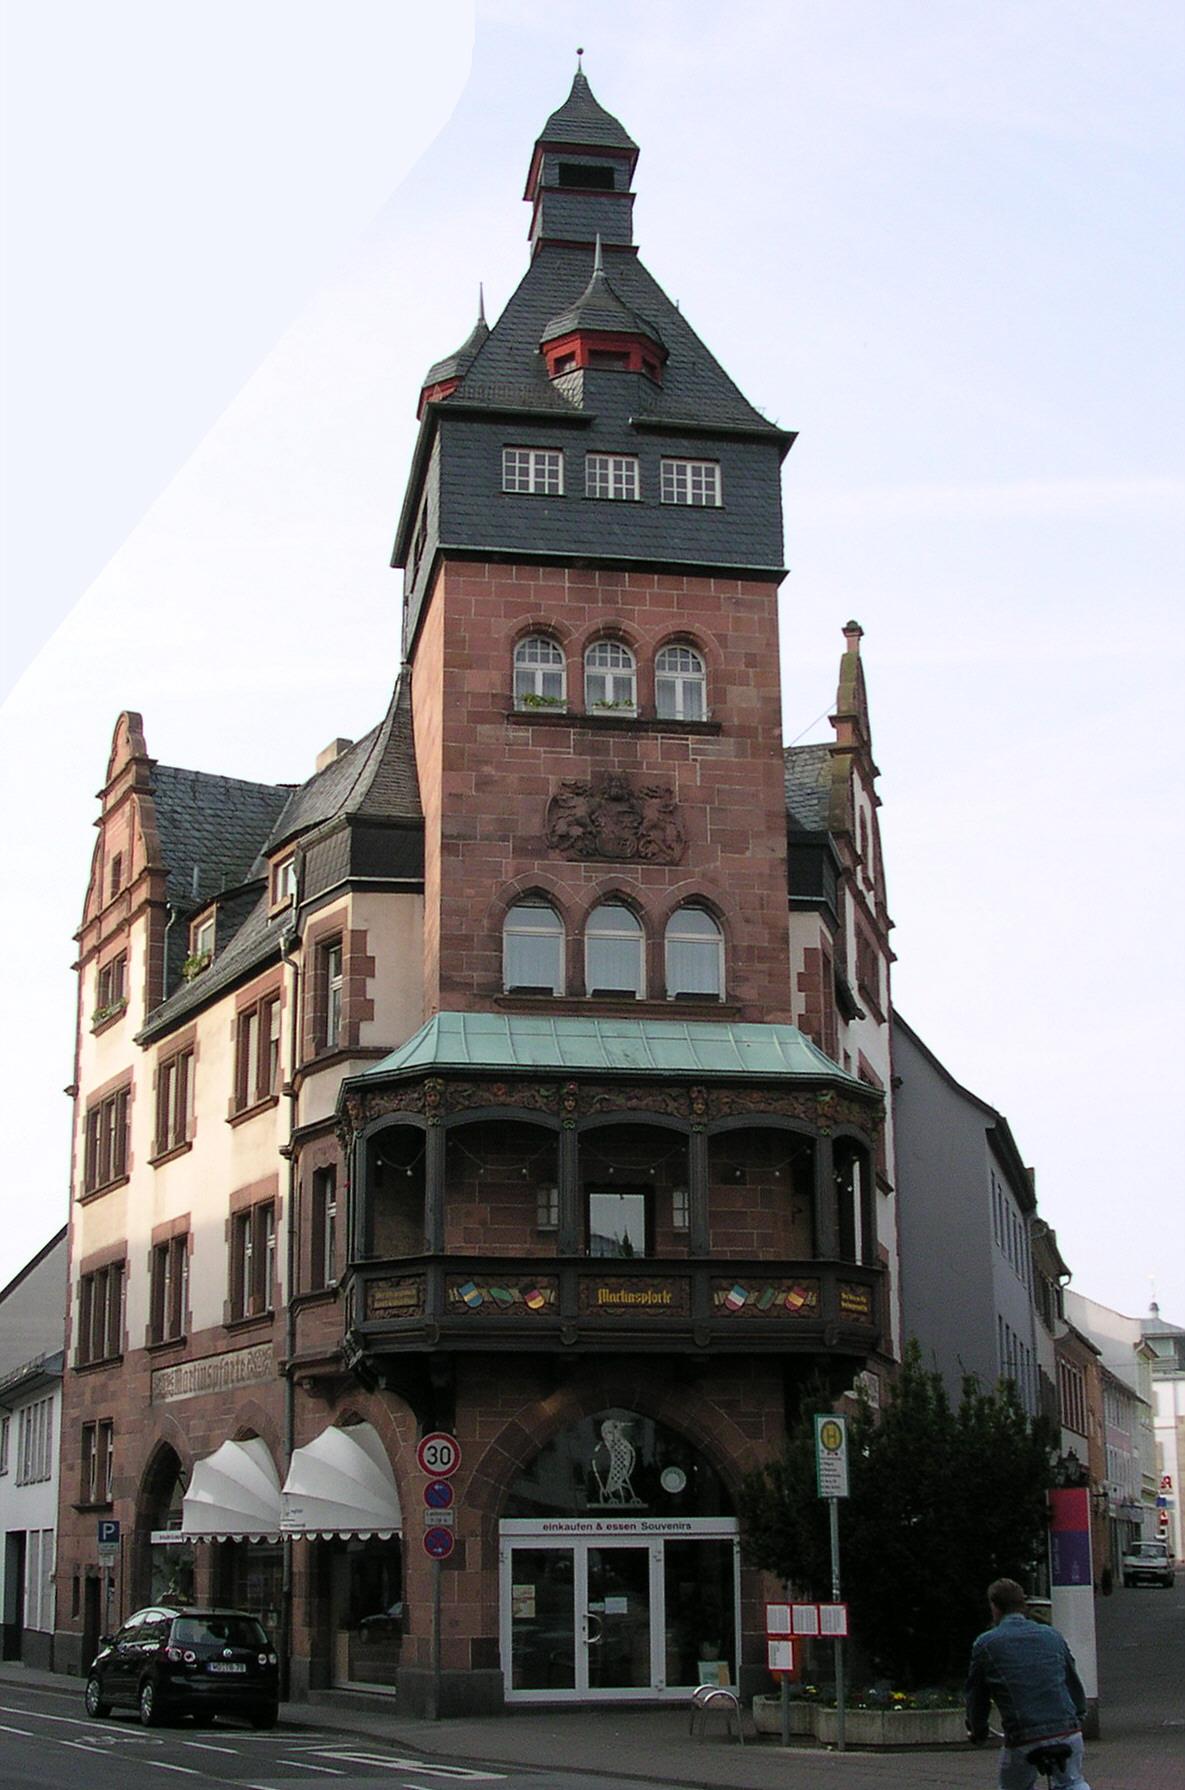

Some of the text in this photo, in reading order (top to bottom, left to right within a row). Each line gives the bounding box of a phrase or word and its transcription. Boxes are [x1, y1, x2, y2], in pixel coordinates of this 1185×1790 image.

[427, 1445, 452, 1466] 30
[102, 1522, 115, 1540] P
[542, 1520, 692, 1532] einkaufen & essen Souvenirs
